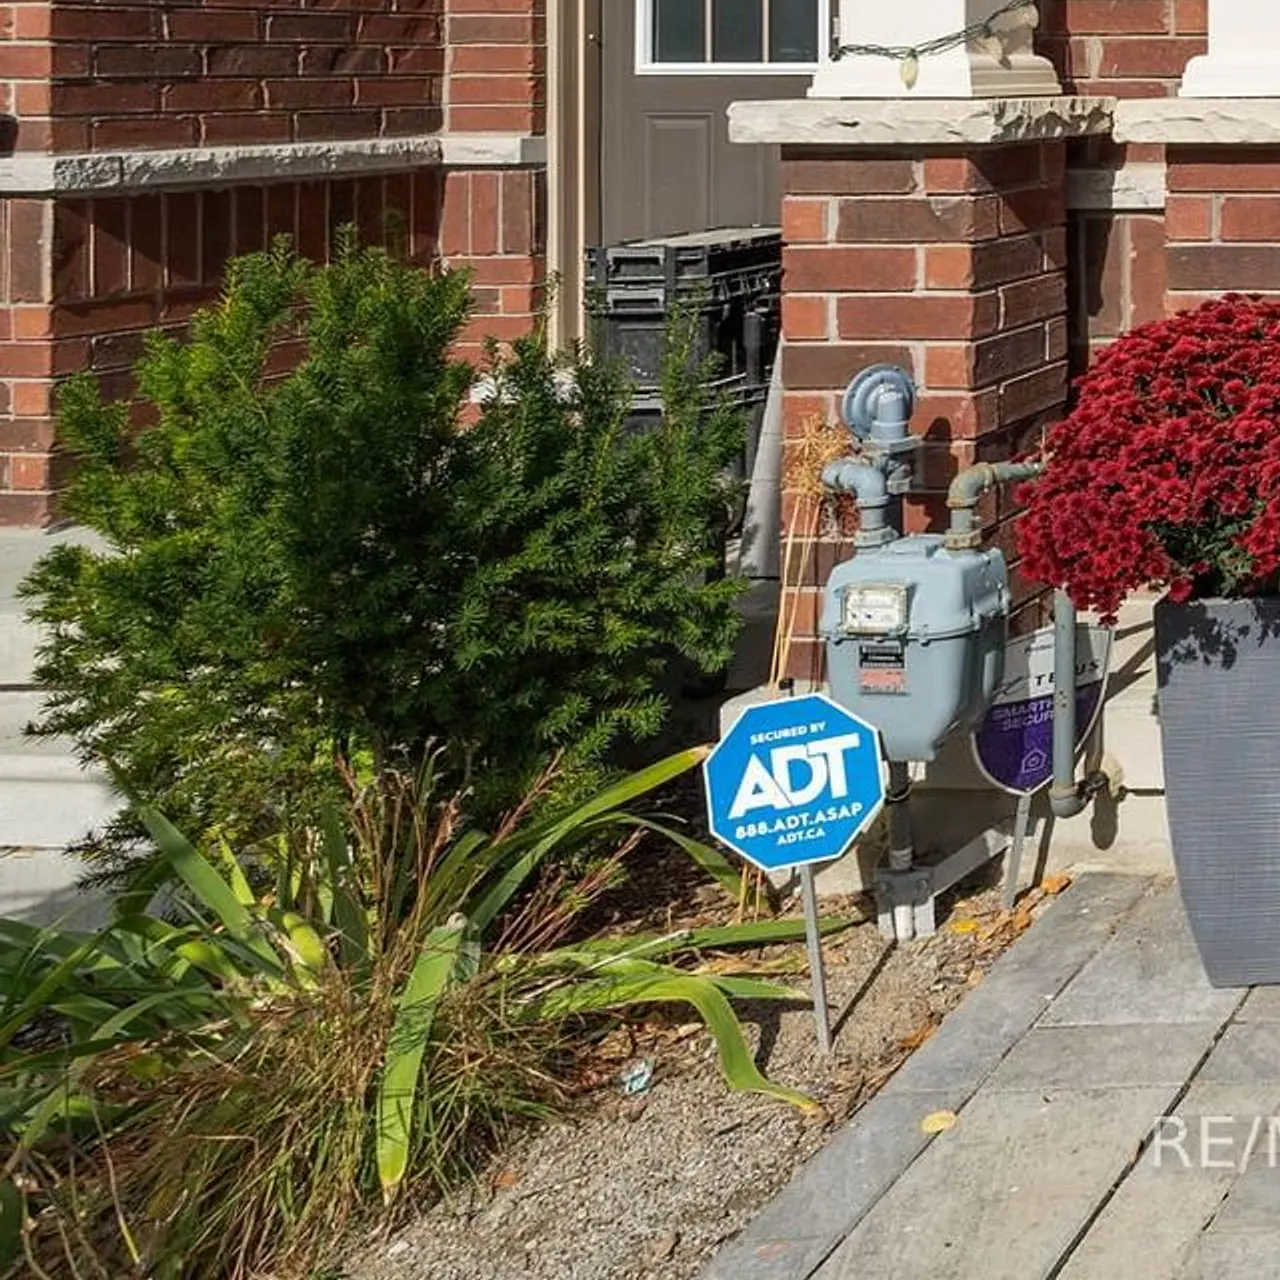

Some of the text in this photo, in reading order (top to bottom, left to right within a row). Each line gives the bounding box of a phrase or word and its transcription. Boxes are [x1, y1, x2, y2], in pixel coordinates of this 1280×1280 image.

[1034, 660, 1099, 686] TEUS
[750, 721, 827, 745] SECURED BY
[727, 732, 860, 820] ADT
[735, 802, 863, 839] 888.ADT.ASAP
[777, 827, 825, 846] ADT.CA
